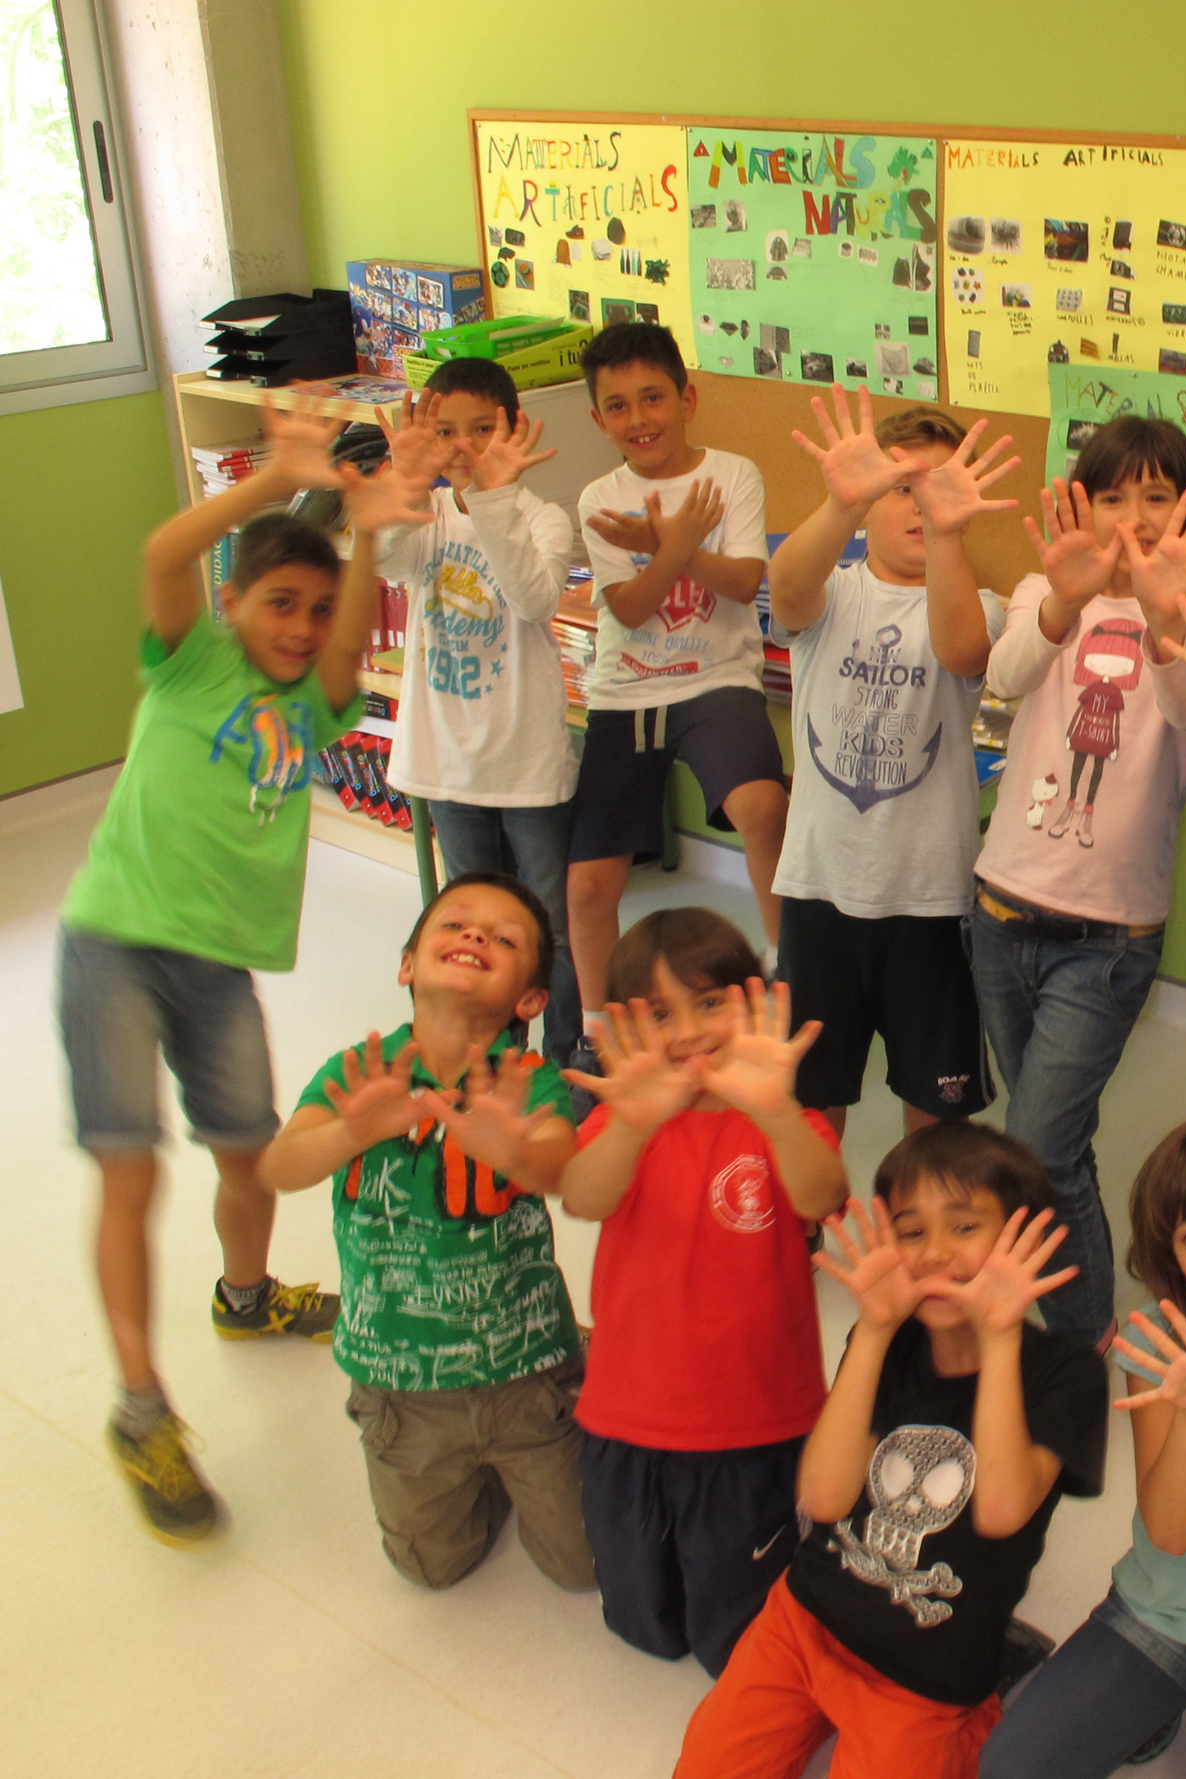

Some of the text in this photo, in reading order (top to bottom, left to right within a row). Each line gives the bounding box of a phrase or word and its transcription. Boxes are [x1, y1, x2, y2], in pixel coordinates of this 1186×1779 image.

[487, 131, 621, 174] MATERIALS
[948, 146, 1039, 169] MATERIALS
[493, 164, 678, 228] ARTIFICIALS
[839, 657, 927, 688] SAILOR
[853, 686, 899, 710] STRONG
[1092, 693, 1110, 714] MY
[831, 703, 919, 736] WATER
[840, 730, 904, 758] KIDS
[834, 752, 907, 785] REVOLUTION
